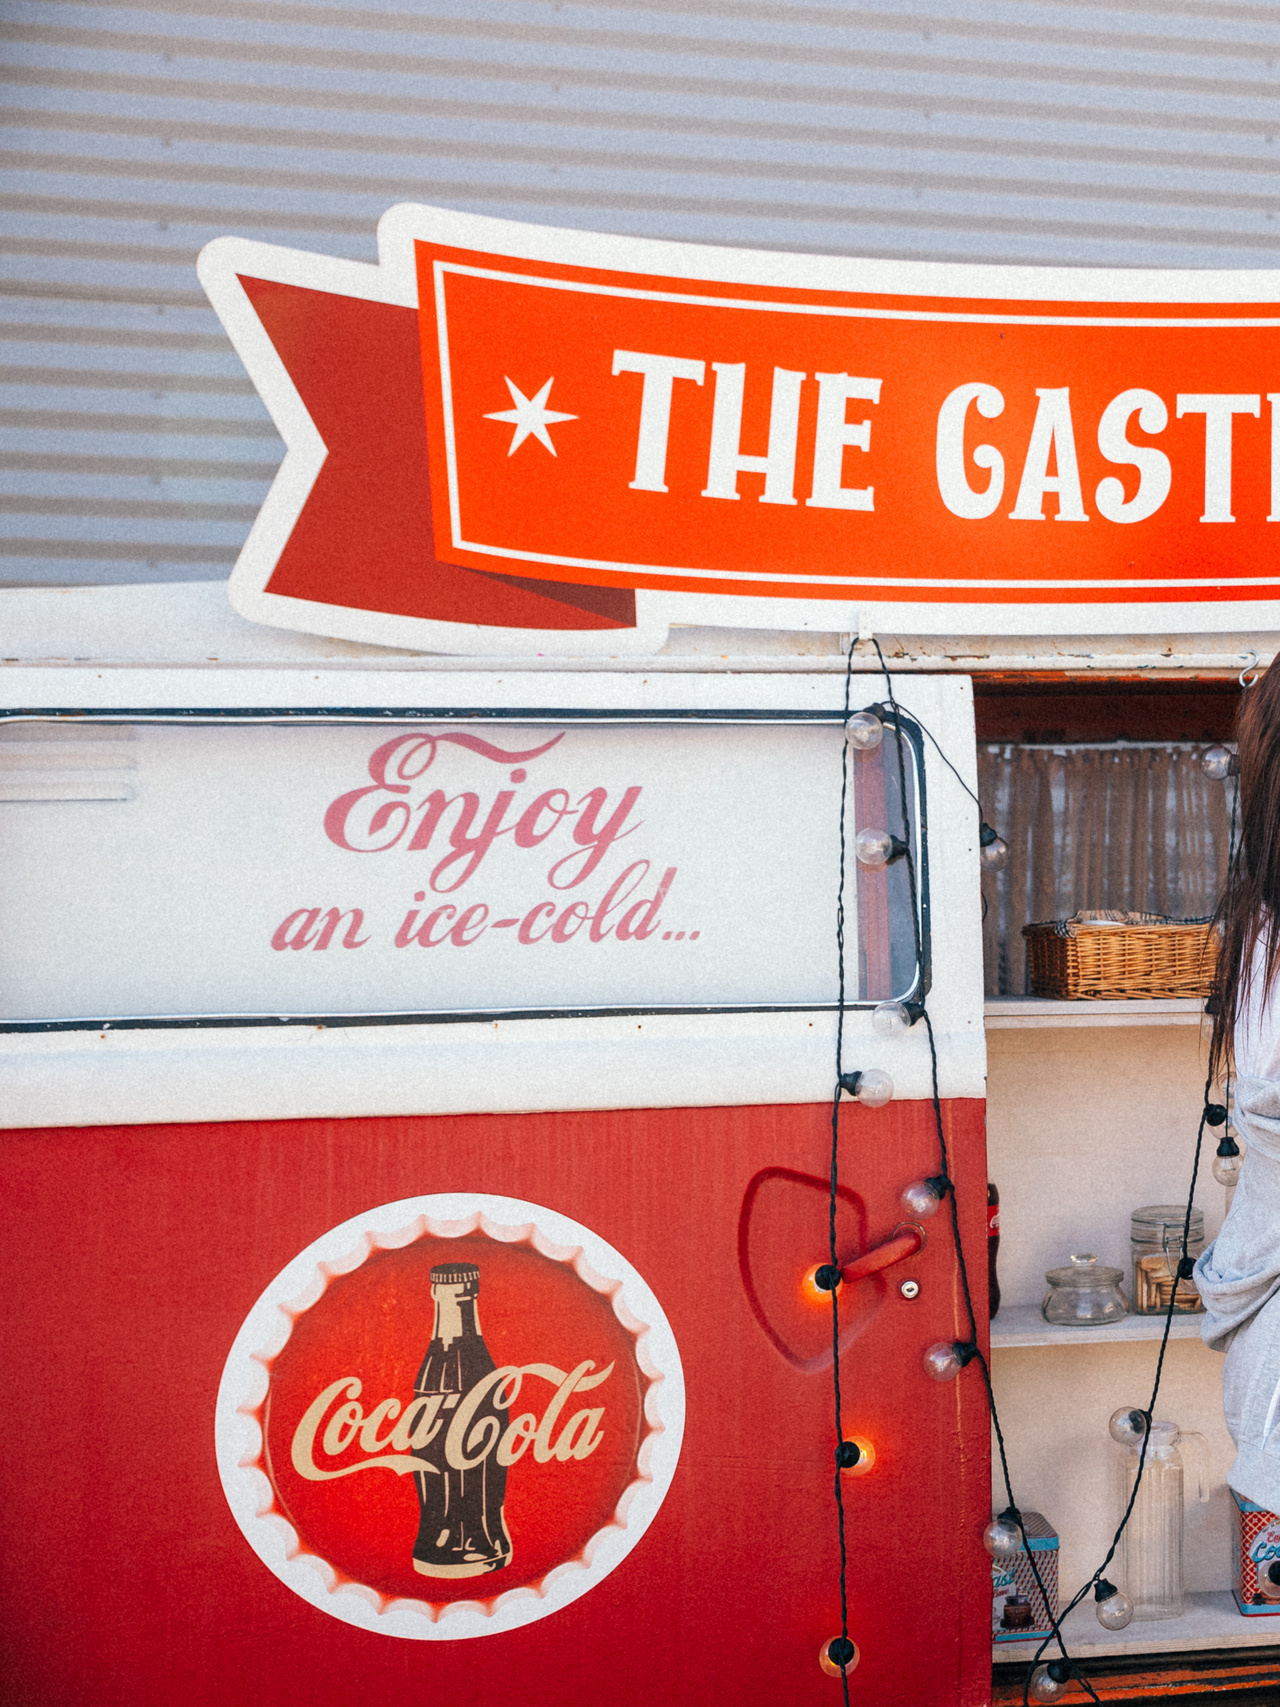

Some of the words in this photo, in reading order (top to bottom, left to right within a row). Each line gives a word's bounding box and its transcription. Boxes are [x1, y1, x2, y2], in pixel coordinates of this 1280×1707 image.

[611, 349, 883, 512] THE
[323, 731, 646, 893] Enjoy
[270, 906, 371, 952] an
[290, 1359, 616, 1482] Coca-Cola
